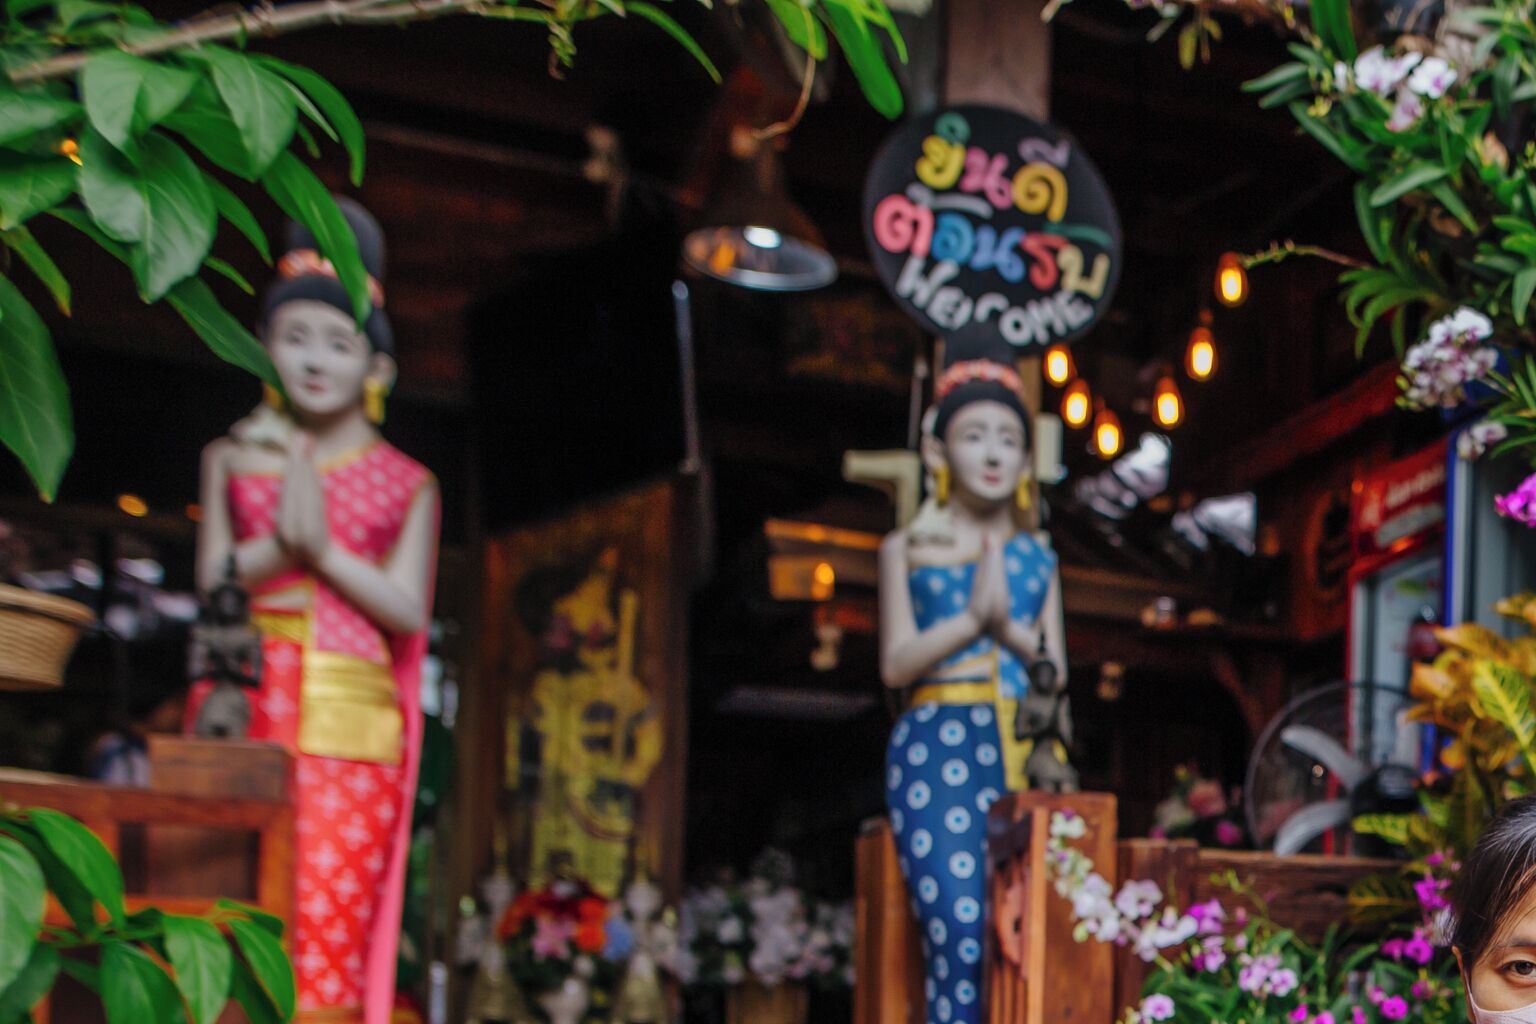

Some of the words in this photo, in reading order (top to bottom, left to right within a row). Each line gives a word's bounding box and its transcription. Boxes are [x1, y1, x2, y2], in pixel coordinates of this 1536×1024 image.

[914, 111, 1070, 223] ยินดี
[873, 182, 1113, 299] ต้อนรับ
